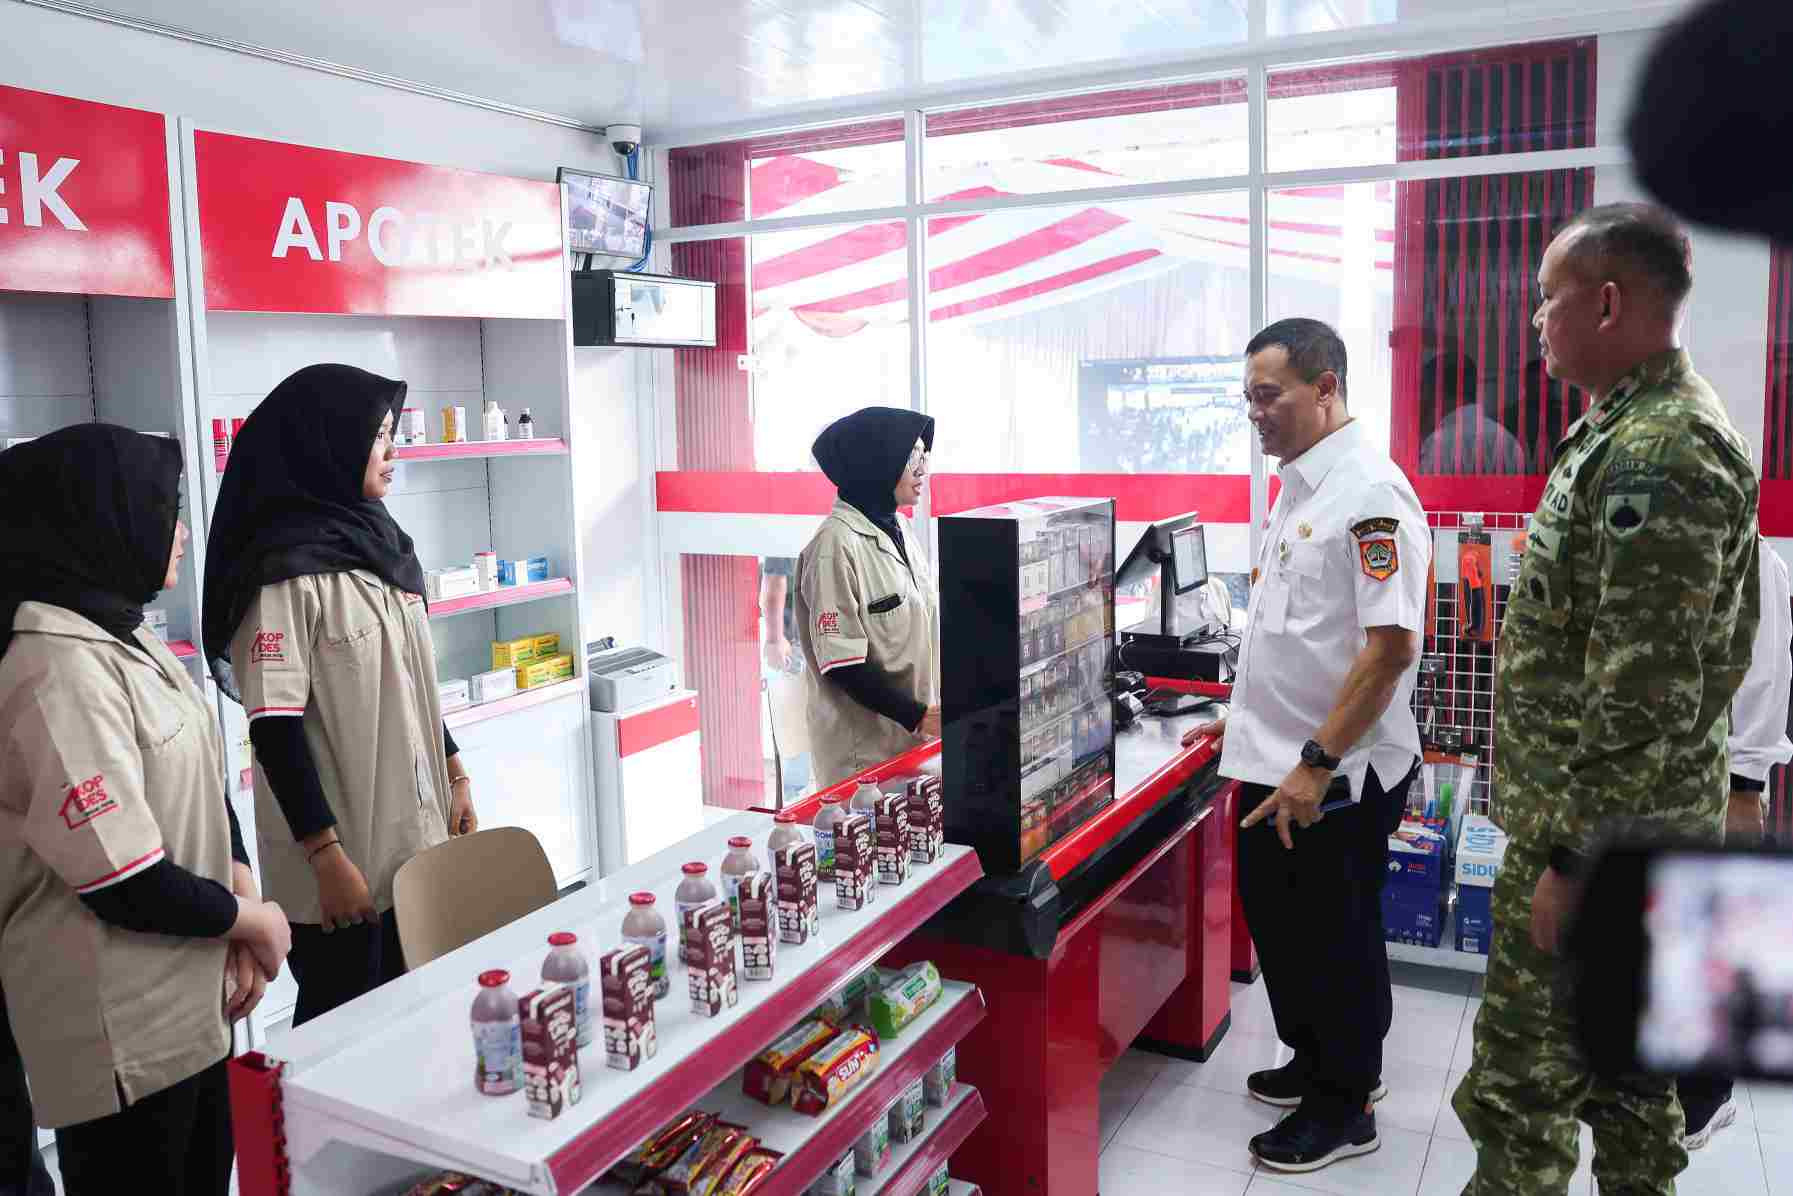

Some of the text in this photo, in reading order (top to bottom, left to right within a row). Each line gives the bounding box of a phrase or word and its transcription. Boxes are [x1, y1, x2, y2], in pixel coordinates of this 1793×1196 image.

[0, 150, 88, 232] K
[272, 197, 513, 268] APOTEK
[259, 632, 284, 642] KOP
[73, 775, 104, 799] KOP
